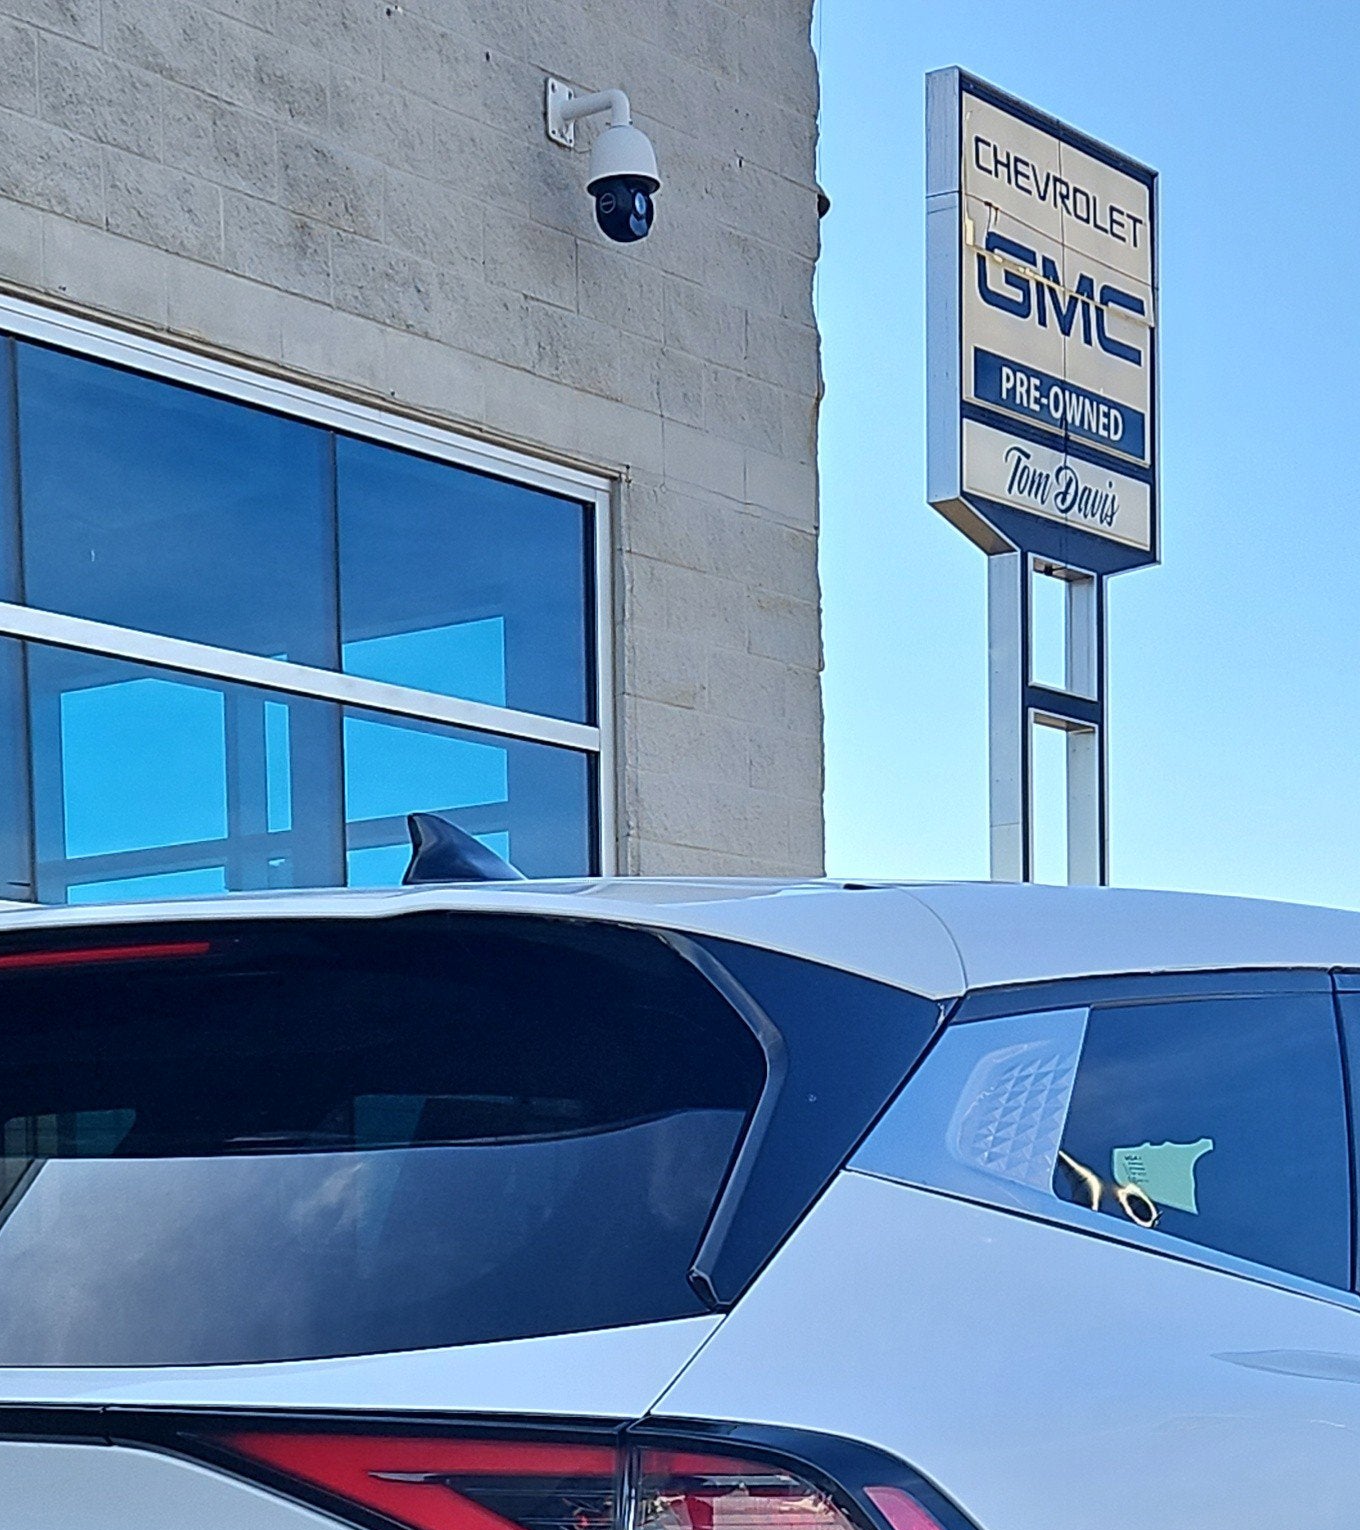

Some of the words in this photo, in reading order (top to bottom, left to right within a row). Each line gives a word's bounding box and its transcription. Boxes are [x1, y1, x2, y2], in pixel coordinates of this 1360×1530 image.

[974, 135, 1143, 248] CHEVROLET
[977, 231, 1143, 366] GMC
[1001, 366, 1122, 442] PRE-OWNED
[1004, 446, 1050, 510] Tom
[1053, 465, 1119, 528] Davis
